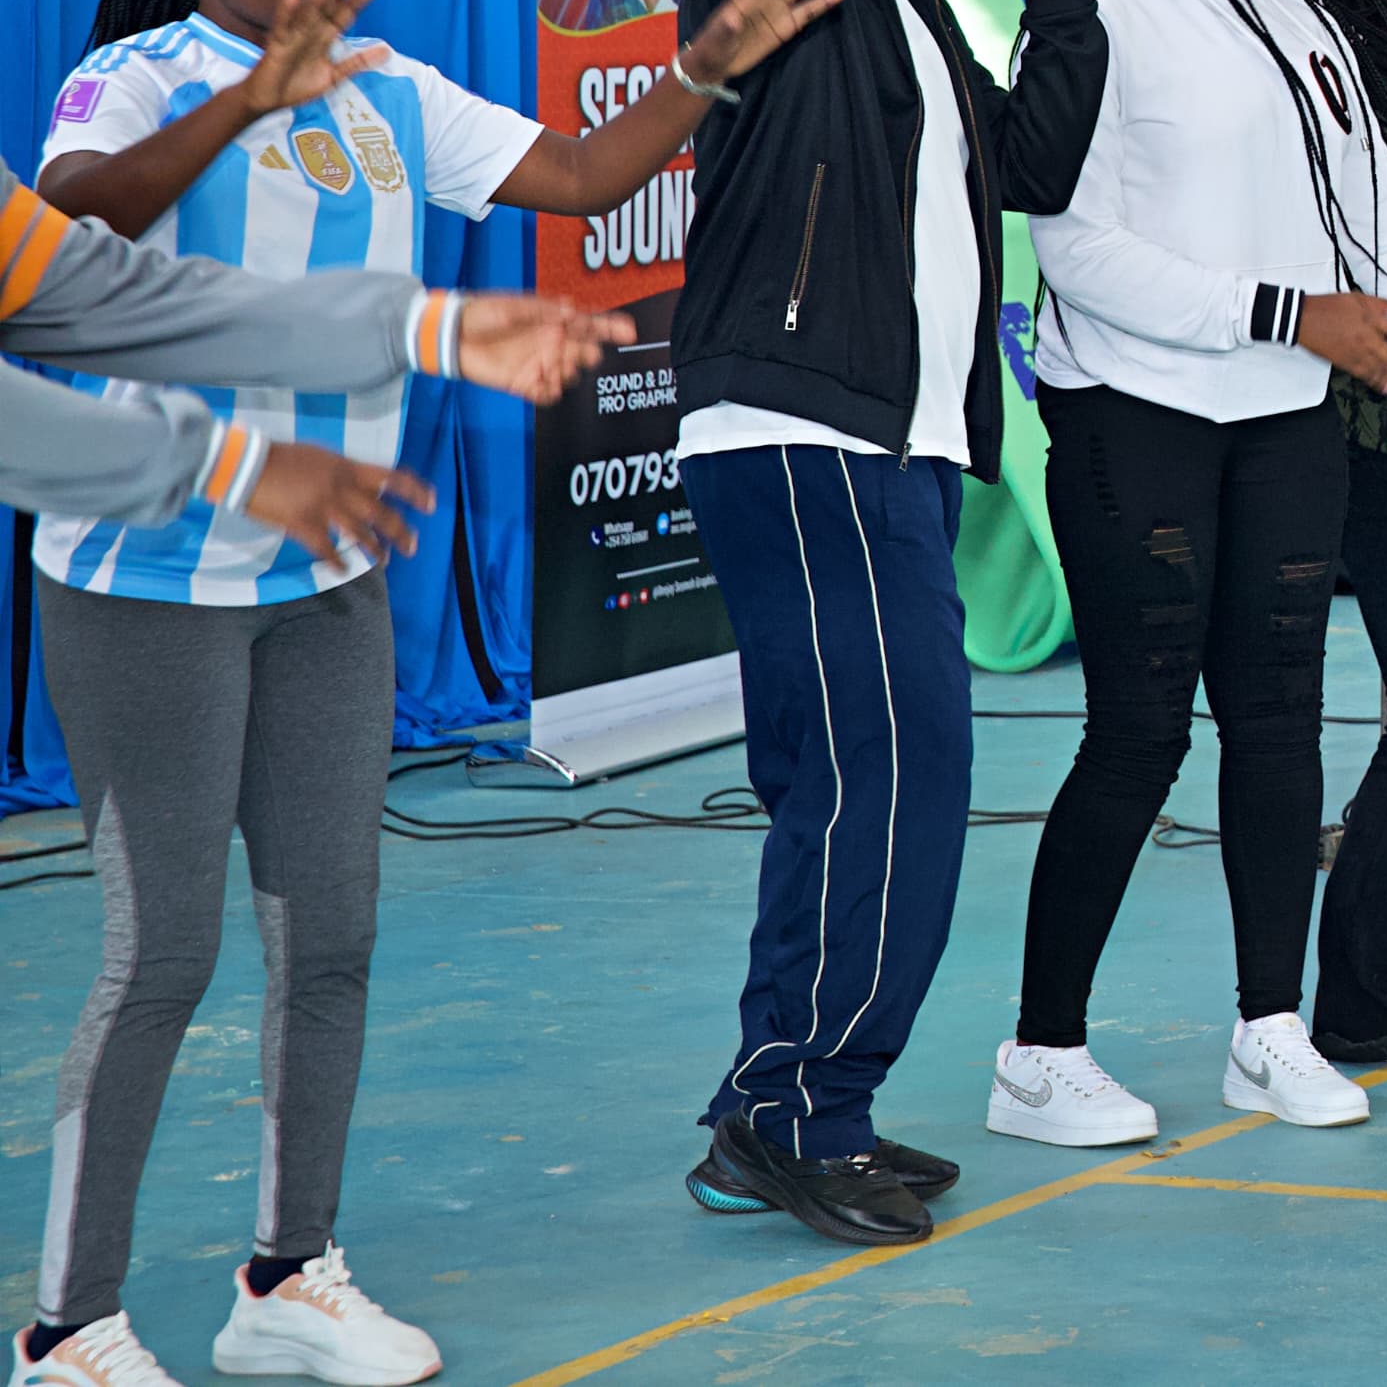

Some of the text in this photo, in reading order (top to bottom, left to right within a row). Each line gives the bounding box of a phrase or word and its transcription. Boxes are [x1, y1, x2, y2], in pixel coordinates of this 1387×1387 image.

[597, 367, 673, 396] SOUND & DJ
[597, 394, 625, 415] PRO
[570, 448, 681, 507] 070793
